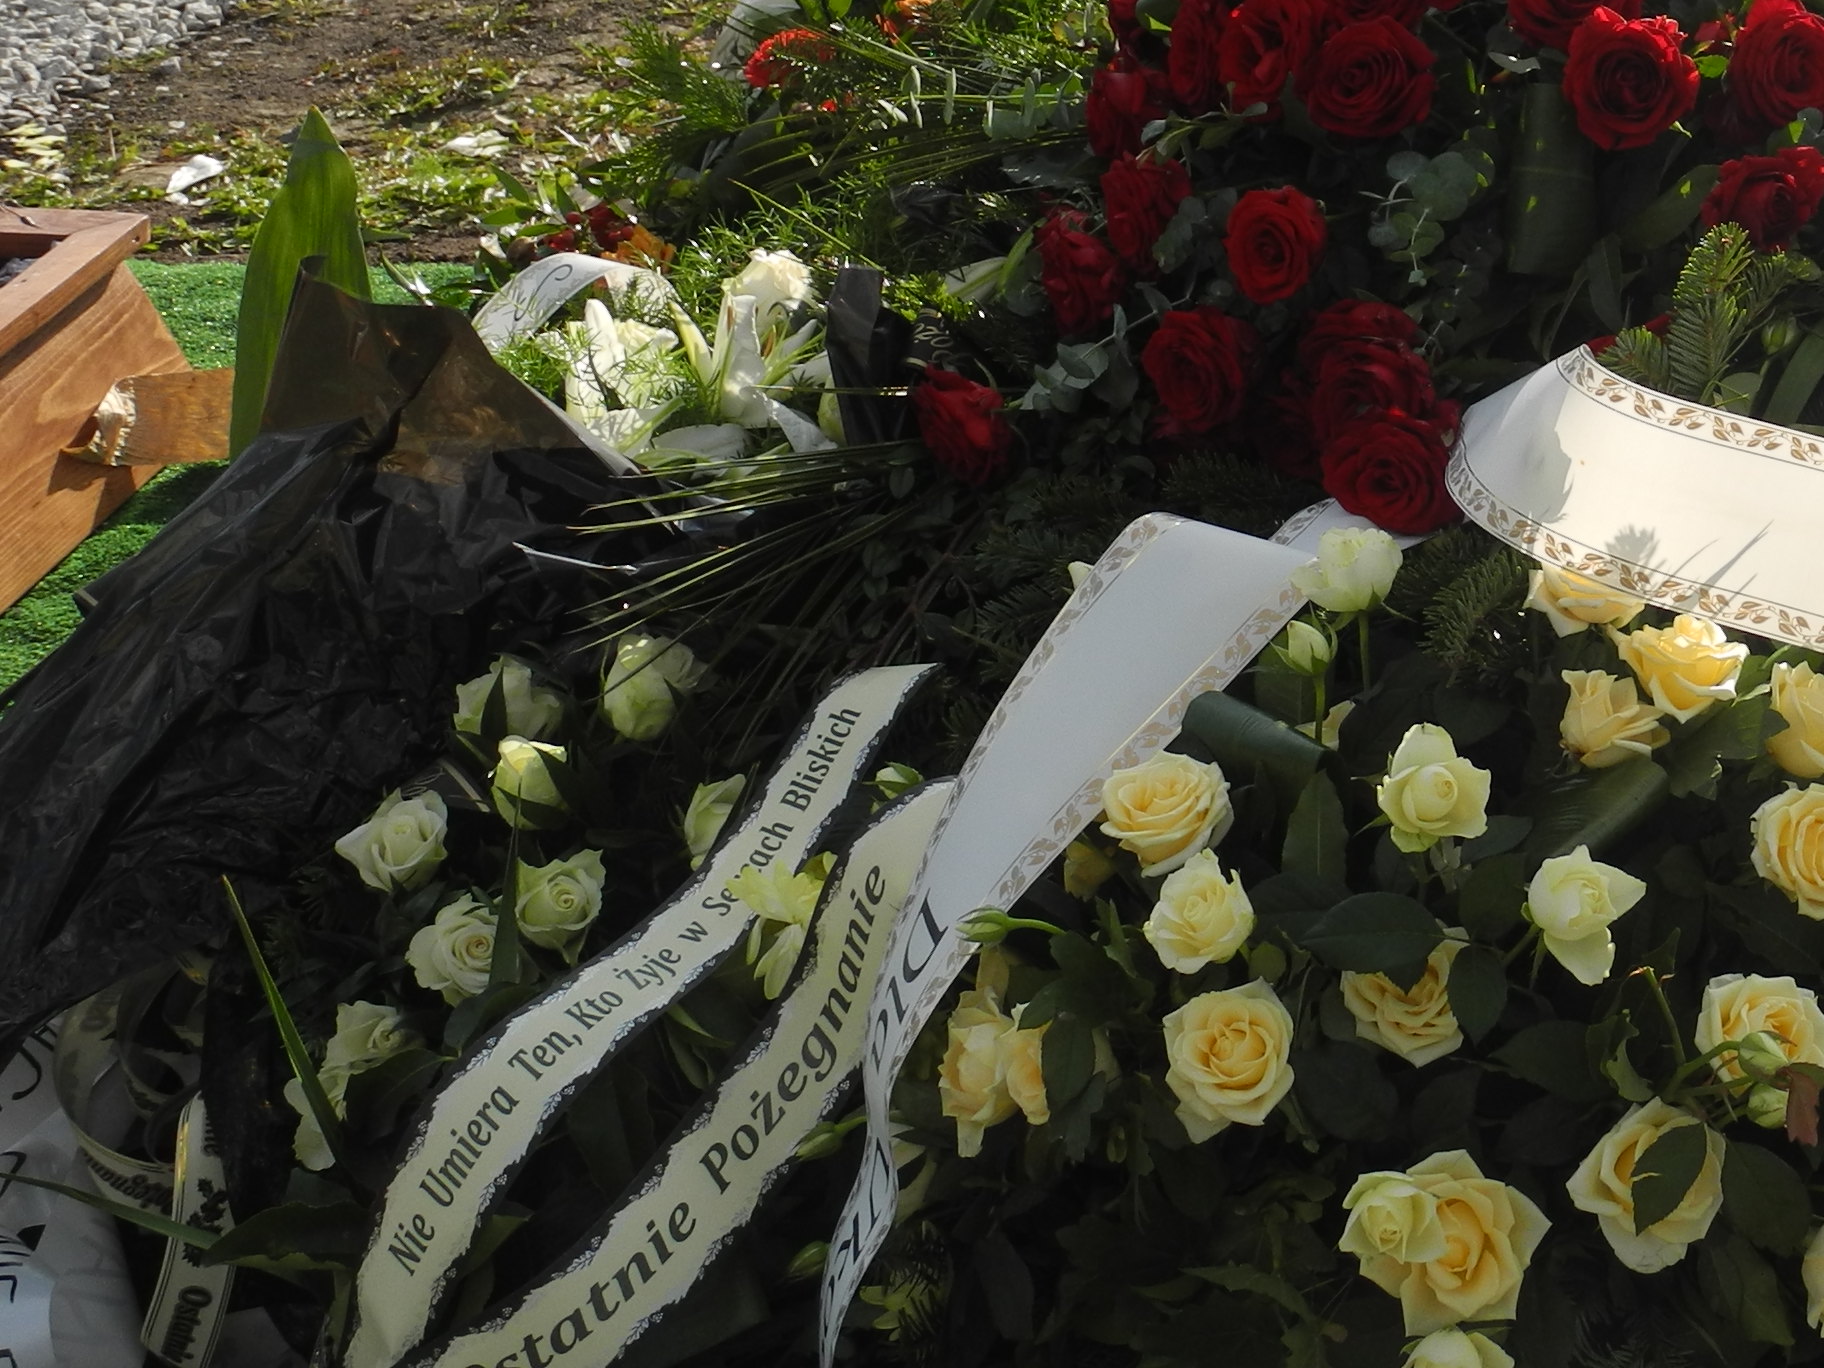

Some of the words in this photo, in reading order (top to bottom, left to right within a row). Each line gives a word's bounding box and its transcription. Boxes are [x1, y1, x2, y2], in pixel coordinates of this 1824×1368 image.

[387, 1209, 436, 1278] Nie
[418, 1085, 521, 1209] Umiera
[613, 943, 683, 1002] Żyje
[677, 918, 712, 946] w
[701, 820, 795, 917] Seach
[779, 707, 863, 813] Bliskich
[699, 863, 887, 1195] Pożegnanie
